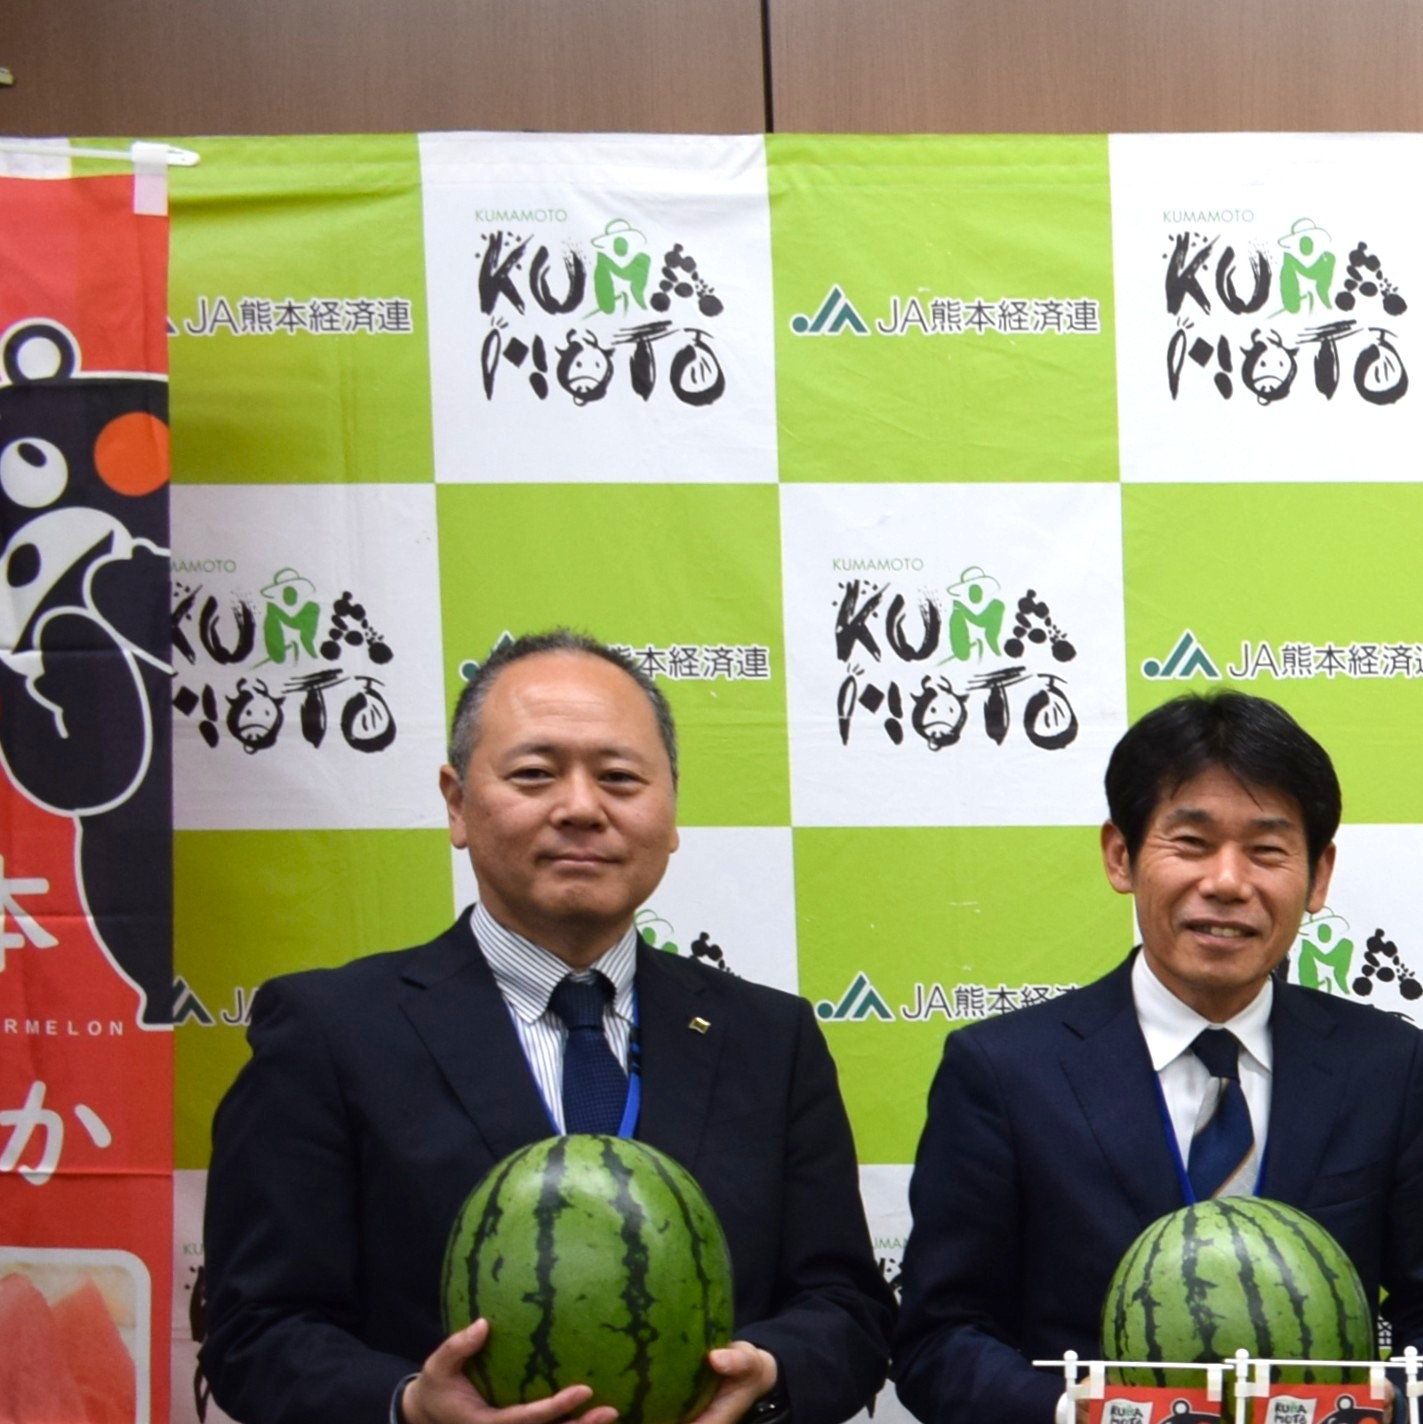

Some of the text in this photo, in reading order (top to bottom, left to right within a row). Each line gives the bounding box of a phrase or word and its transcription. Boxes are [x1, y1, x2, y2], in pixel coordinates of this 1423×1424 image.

[475, 209, 567, 222] KUMAMOTO
[1163, 210, 1255, 223] KUMAMOTO
[478, 219, 724, 316] KUMA
[1163, 218, 1408, 317] KUMA
[188, 300, 408, 333] JA熊本経済連
[878, 300, 1095, 332] JA熊本経済連
[480, 320, 725, 406] MOTO
[1166, 322, 1408, 406] MOTO
[832, 559, 924, 572] KUMAMOTO
[834, 566, 1077, 664] KUMA
[613, 647, 766, 679] 本経済連
[838, 663, 1079, 751] MOTO
[1276, 906, 1423, 1000] MA
[903, 986, 1080, 1019] JA熊本経
[4, 1019, 124, 1035] RMELON
